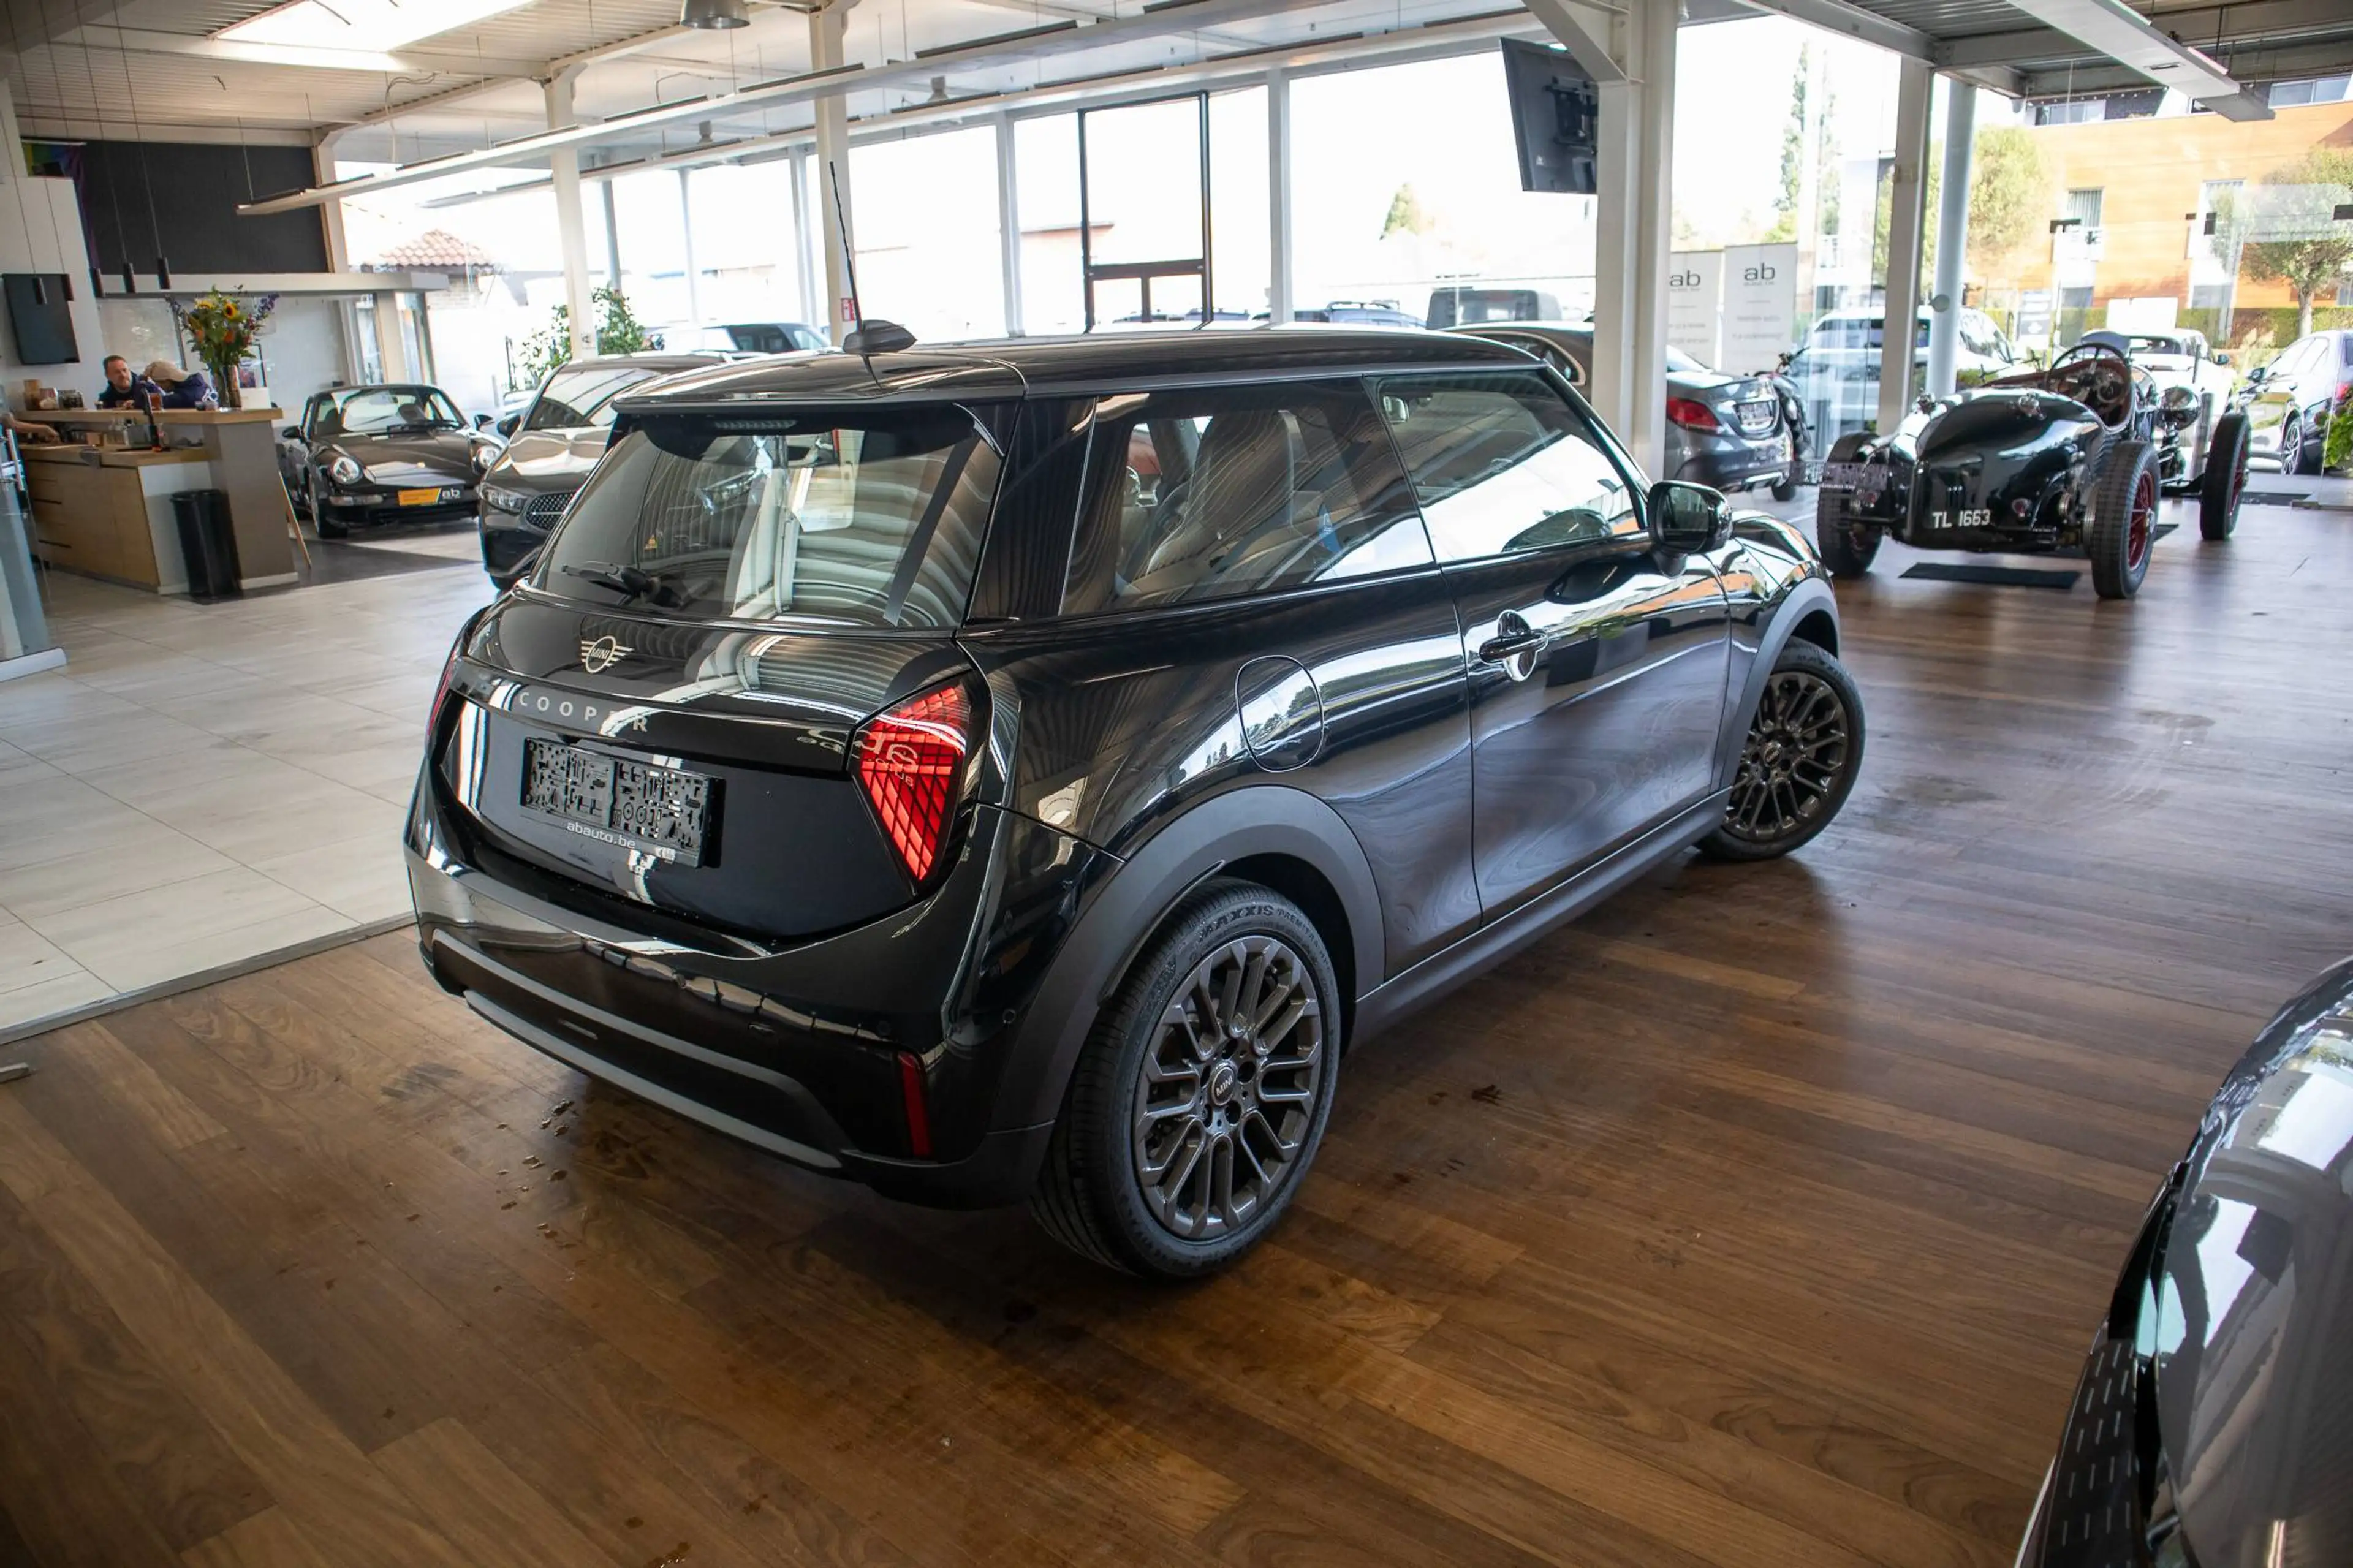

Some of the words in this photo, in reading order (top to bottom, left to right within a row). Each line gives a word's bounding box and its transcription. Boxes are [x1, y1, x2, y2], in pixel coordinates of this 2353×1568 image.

[1670, 270, 1701, 287] ab
[1744, 262, 1776, 281] ab
[1932, 510, 1953, 528] TL
[1958, 509, 1991, 527] 1663
[590, 647, 612, 659] MINI
[520, 692, 647, 733] COOPR
[566, 821, 636, 849] abauto.be
[1215, 1075, 1233, 1097] MINI
